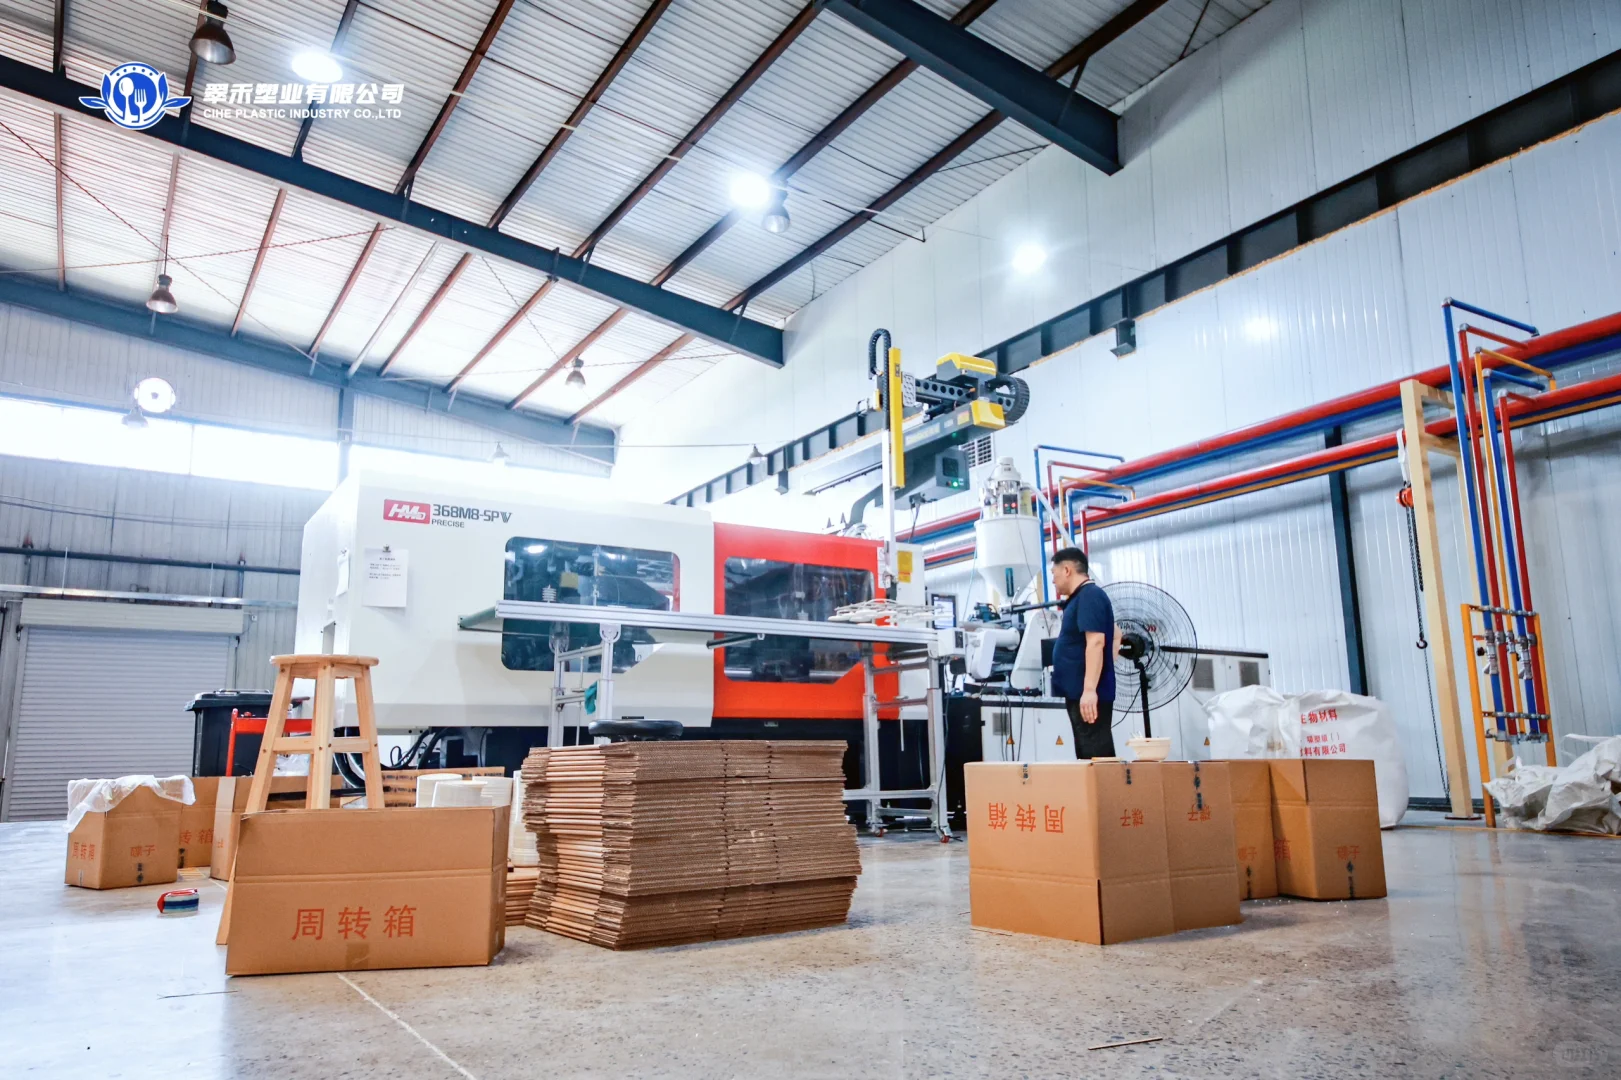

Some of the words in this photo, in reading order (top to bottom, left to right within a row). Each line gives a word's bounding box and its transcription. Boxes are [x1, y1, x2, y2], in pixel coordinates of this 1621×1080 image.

[431, 518, 465, 529] PRECISE
[987, 802, 1066, 834] 周转箱
[290, 904, 418, 941] 周转箱
